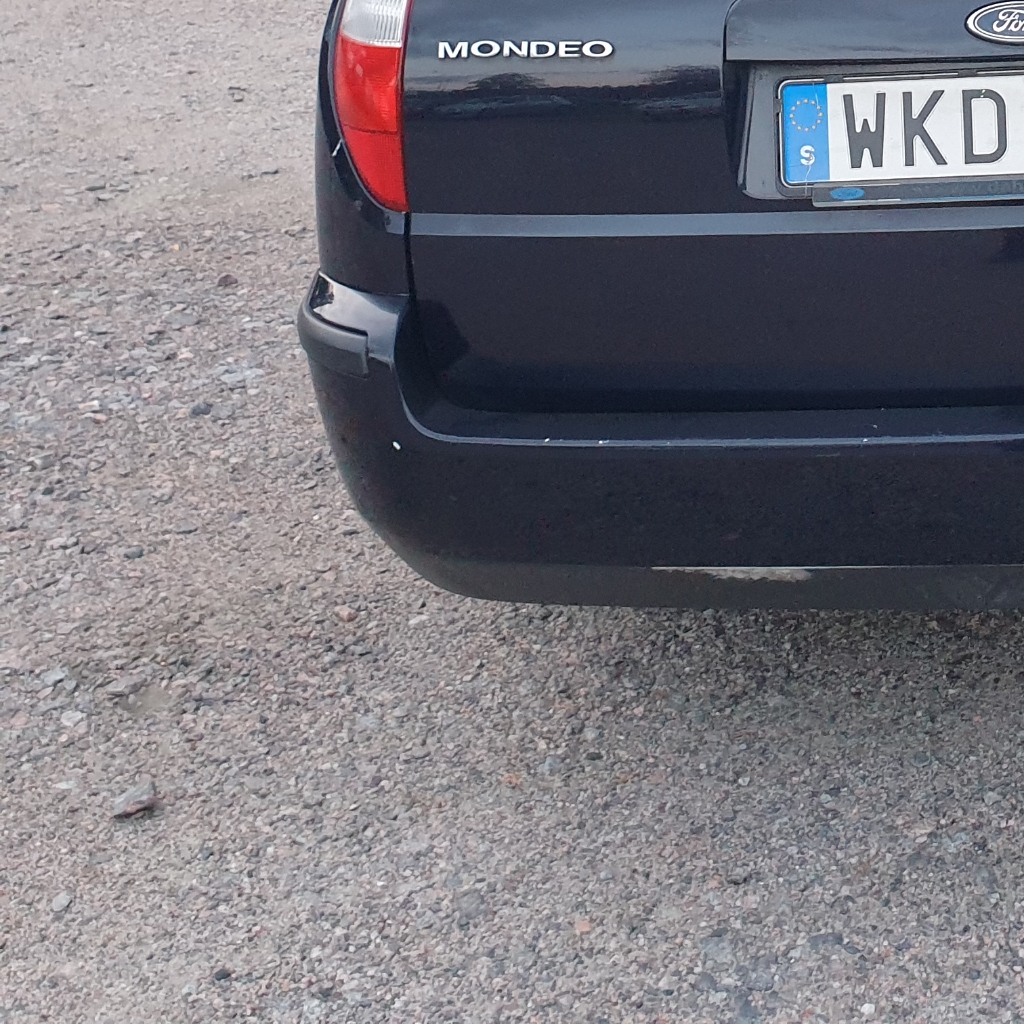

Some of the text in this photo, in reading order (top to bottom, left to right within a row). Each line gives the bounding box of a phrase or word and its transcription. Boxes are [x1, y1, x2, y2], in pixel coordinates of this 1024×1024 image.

[437, 39, 614, 60] MONDEO
[799, 144, 817, 167] S
[843, 88, 1008, 169] WKD
